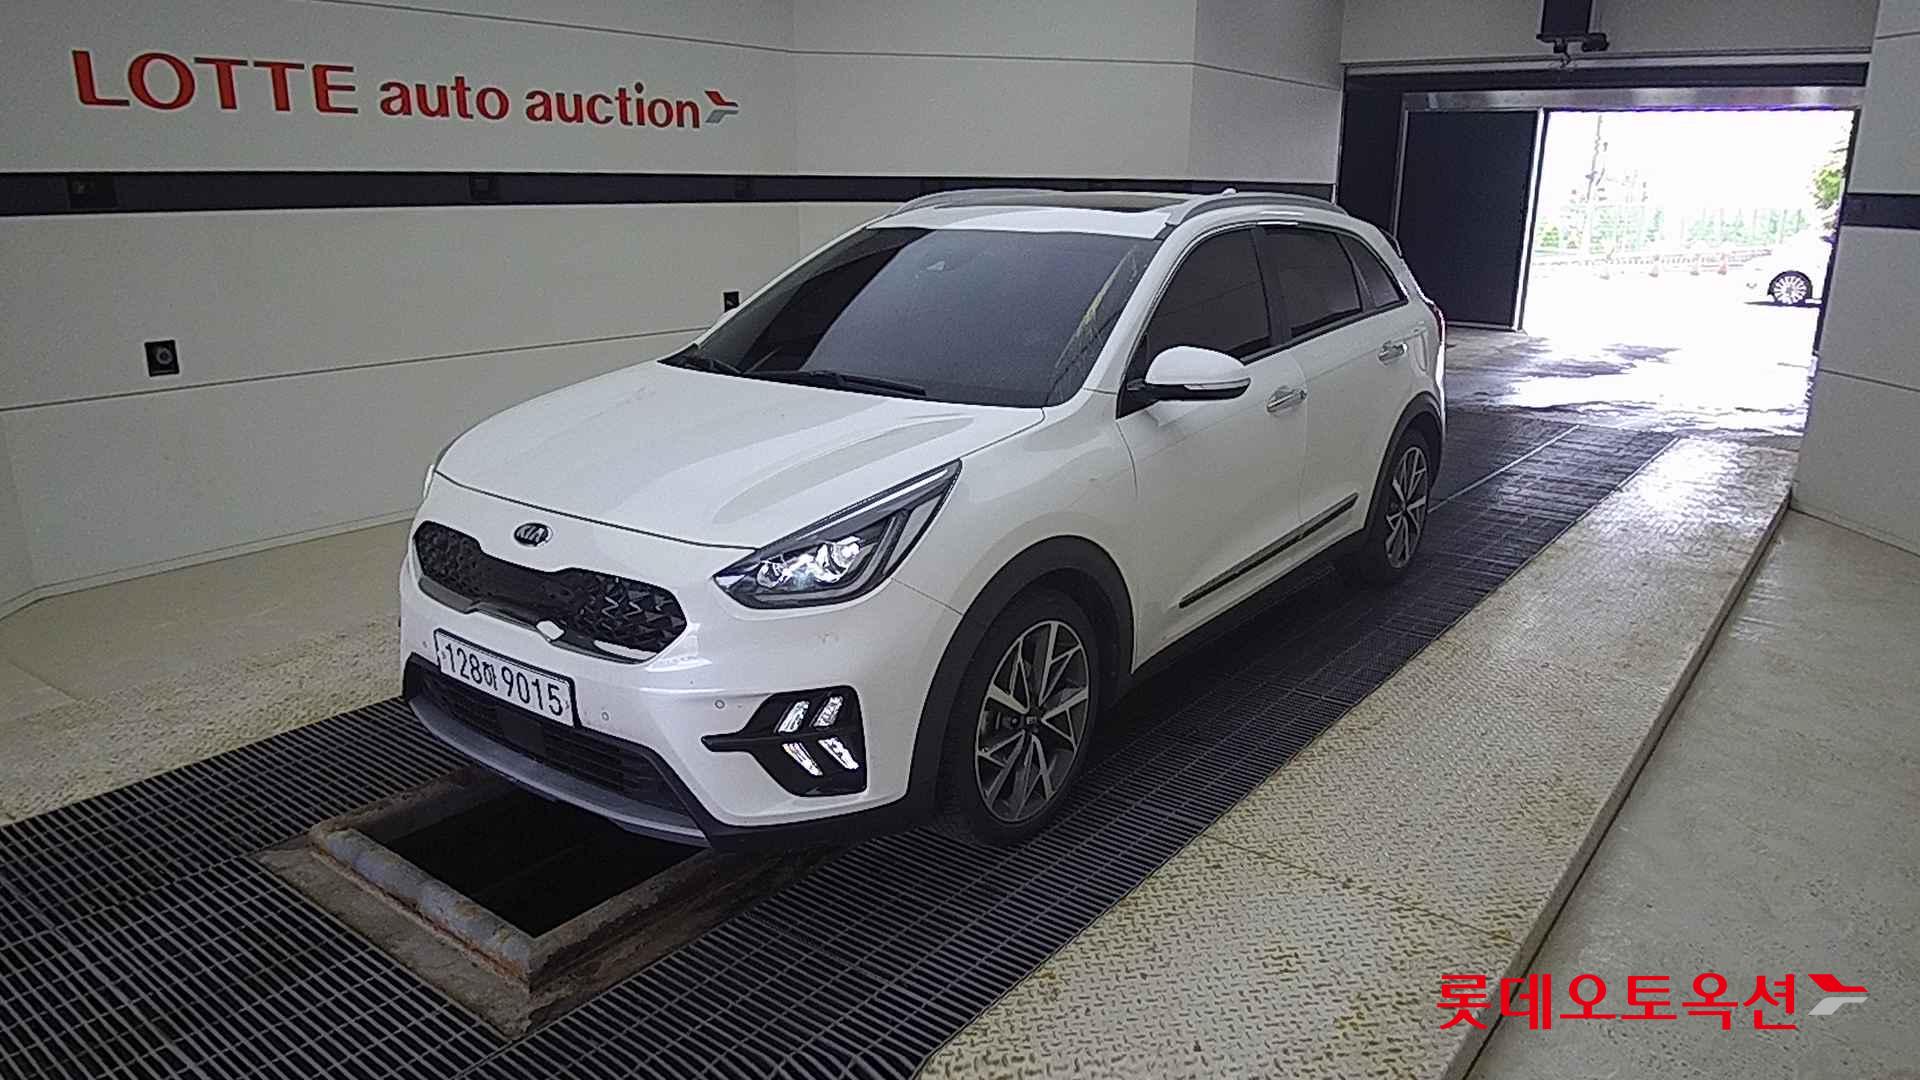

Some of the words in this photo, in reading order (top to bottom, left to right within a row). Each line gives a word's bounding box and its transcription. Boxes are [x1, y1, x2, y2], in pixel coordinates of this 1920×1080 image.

[72, 49, 358, 114] LOTTE
[379, 76, 510, 120] auto
[525, 82, 701, 129] auction
